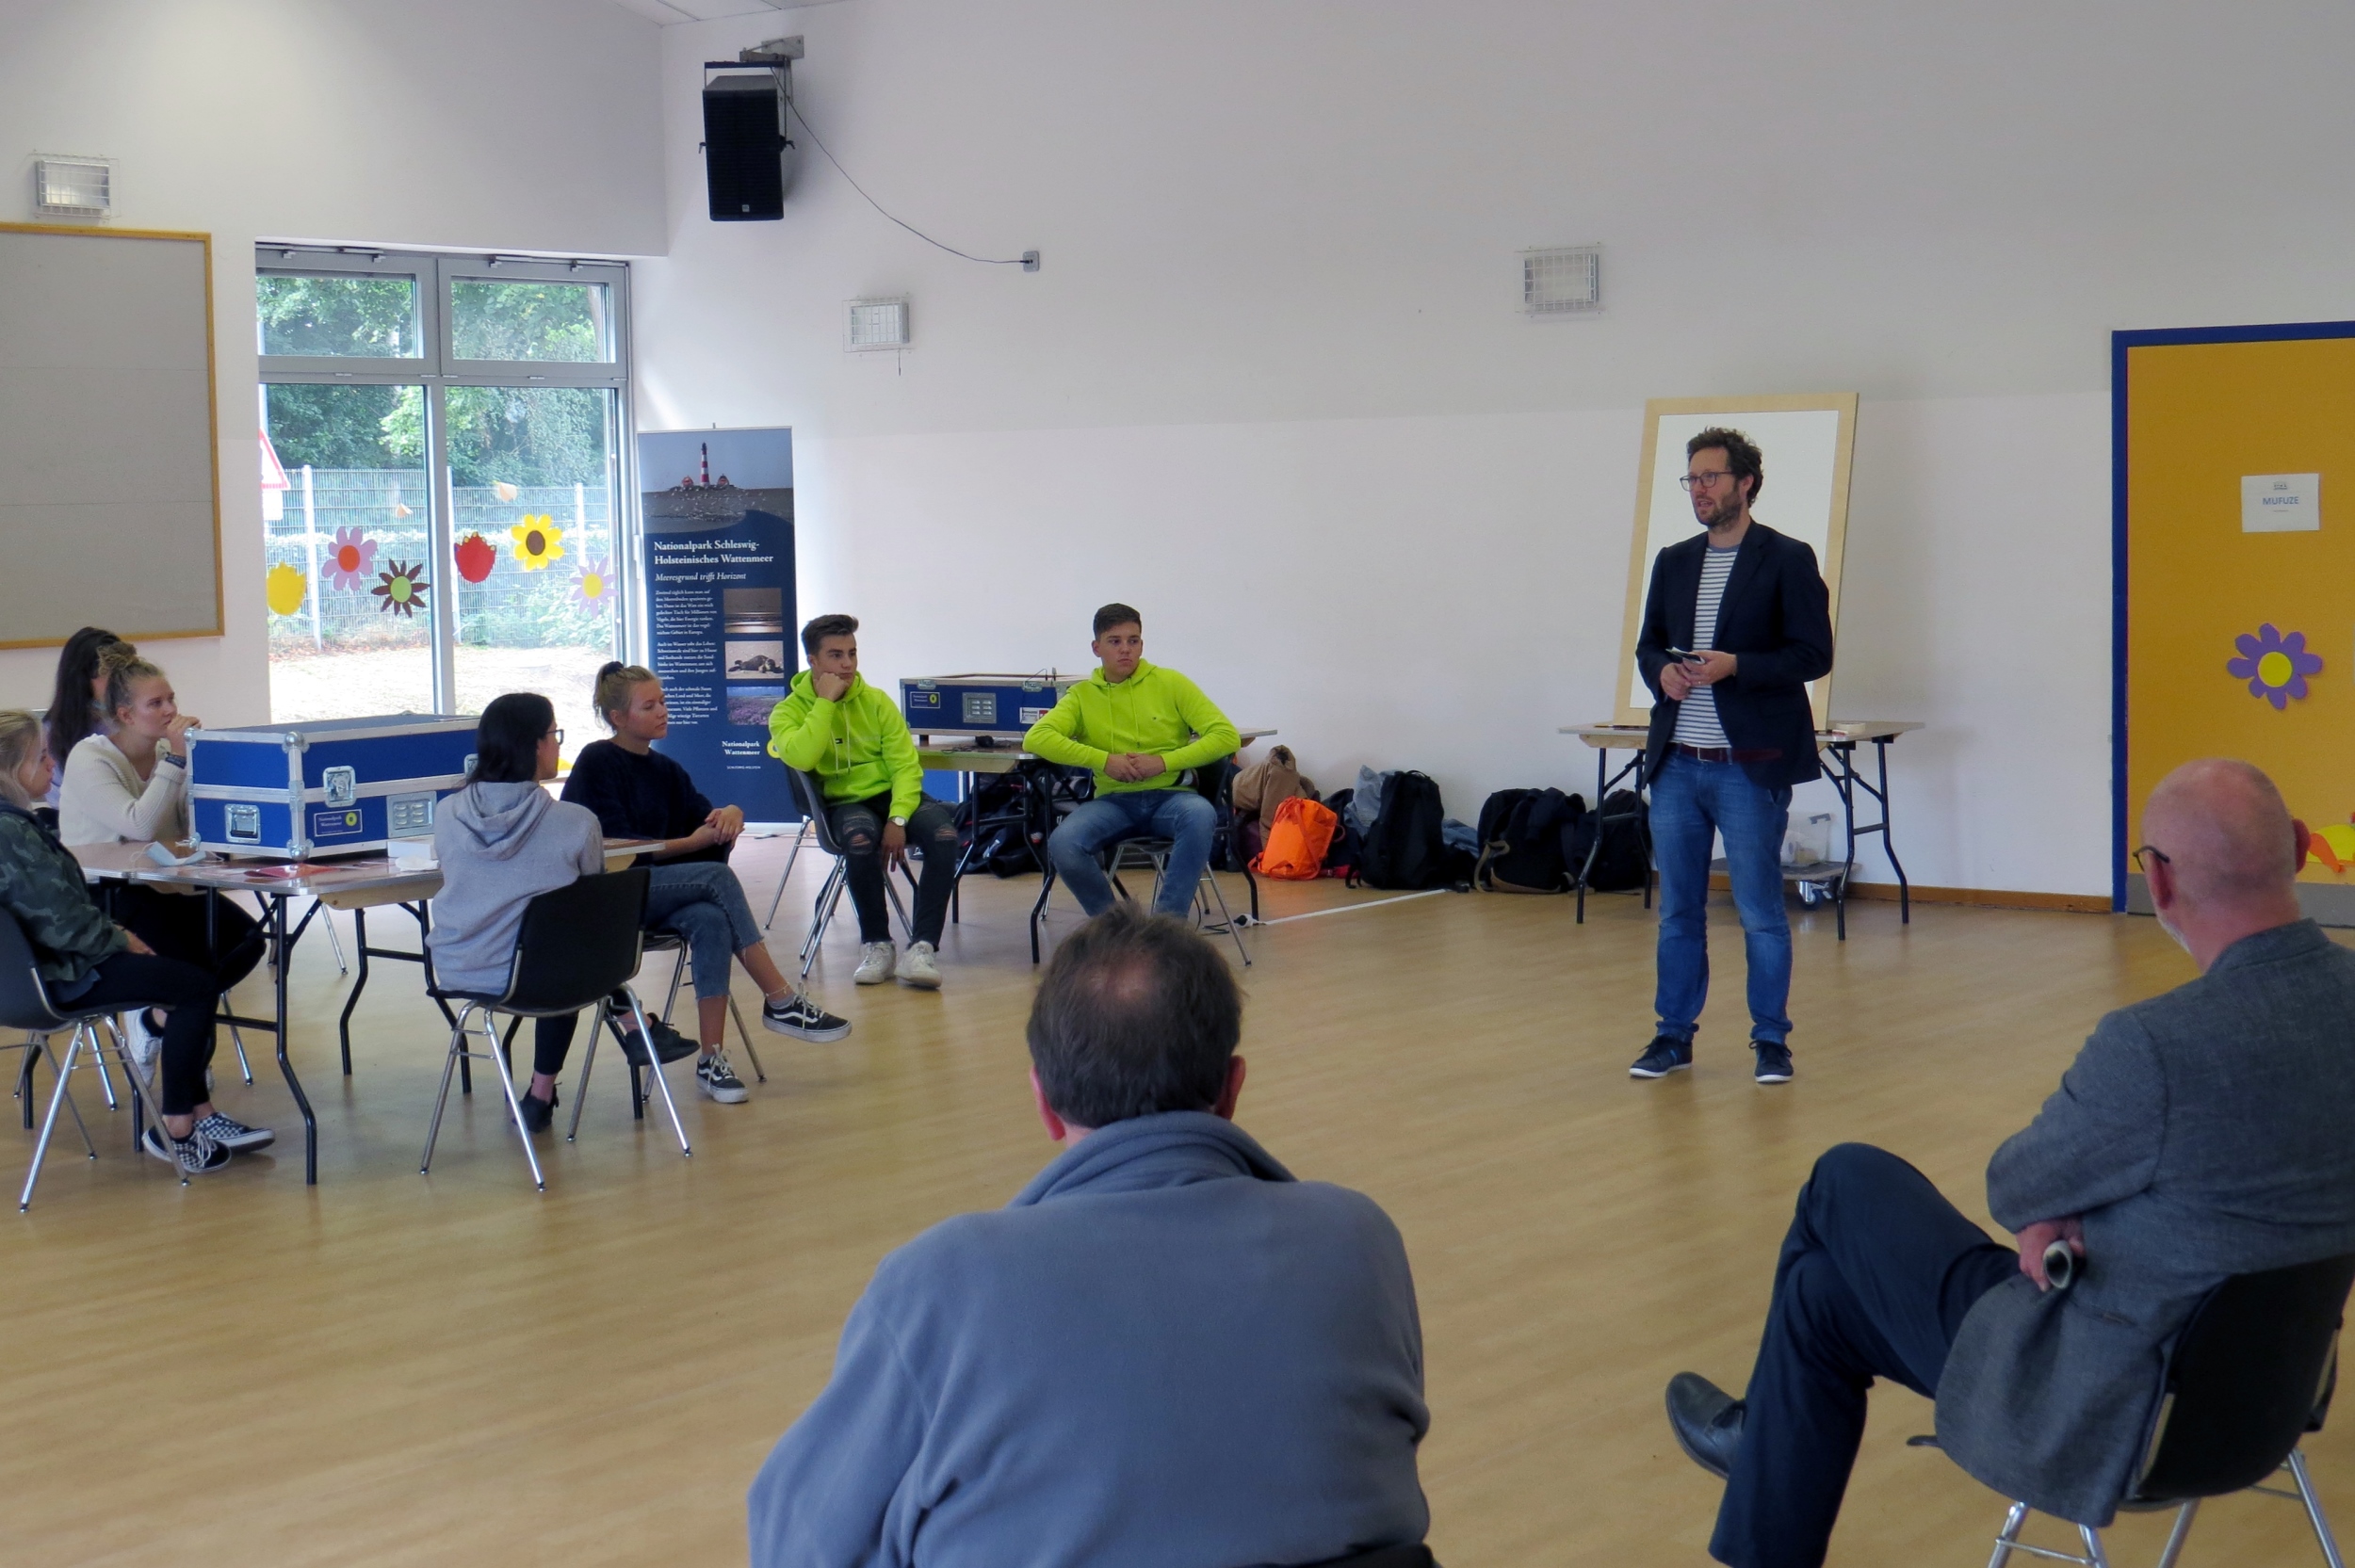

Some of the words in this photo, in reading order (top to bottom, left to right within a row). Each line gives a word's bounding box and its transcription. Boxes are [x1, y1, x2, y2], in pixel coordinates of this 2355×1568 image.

[2263, 496, 2299, 505] MUFUZE
[654, 540, 713, 552] Nationalpark
[714, 540, 760, 551] Schleswig-
[654, 554, 719, 565] Holsteinisches
[721, 554, 774, 563] Wattenmeer
[655, 572, 699, 583] Meeresgrund
[699, 571, 716, 583] trifft
[716, 572, 747, 580] Horizont
[722, 740, 760, 749] Nationalpark
